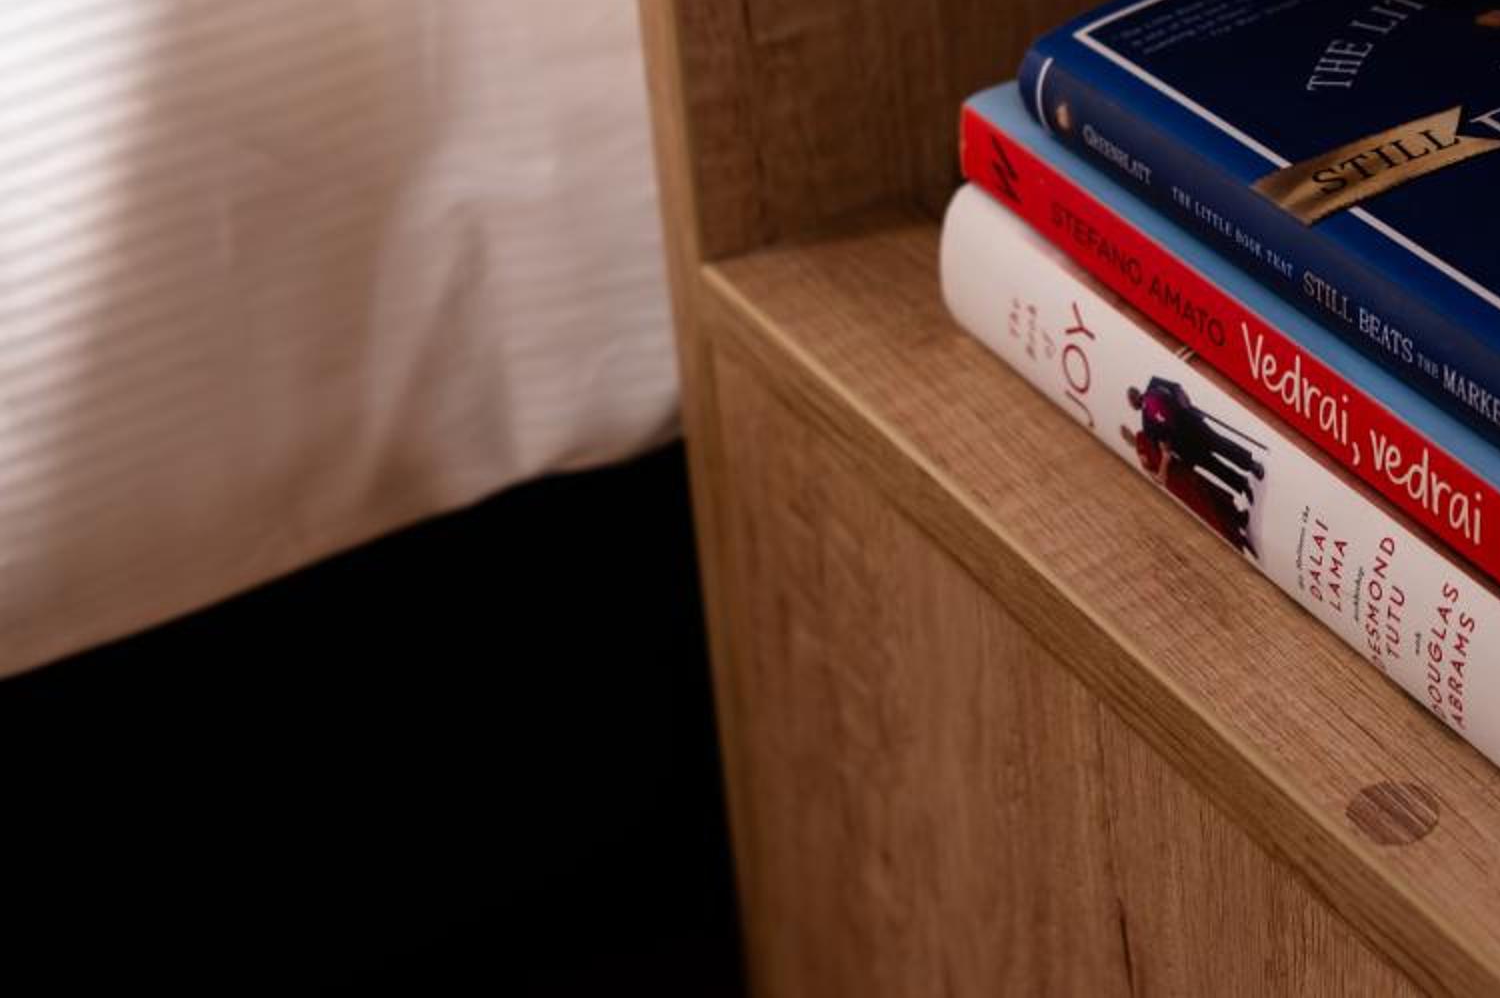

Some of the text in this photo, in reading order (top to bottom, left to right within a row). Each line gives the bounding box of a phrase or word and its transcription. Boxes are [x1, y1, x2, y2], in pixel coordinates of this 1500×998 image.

[1306, 38, 1376, 92] THE
[1310, 128, 1461, 194] STILL
[1050, 200, 1226, 347] STEFANO AMATO
[1194, 200, 1232, 238] LITTLE
[1303, 269, 1352, 324] STILL
[1358, 306, 1414, 363] BEATS
[1416, 352, 1440, 379] THE
[1061, 301, 1096, 428] JOY
[1241, 320, 1360, 467] Vedrai,
[1369, 428, 1482, 546] vedrai
[1309, 518, 1328, 602] DALAI
[1327, 540, 1348, 613] LAMA
[1365, 536, 1396, 672] DESMOND
[1385, 585, 1405, 660] TUTU
[1426, 582, 1459, 721] DOUGLAS
[1447, 612, 1476, 731] ABRAMS
